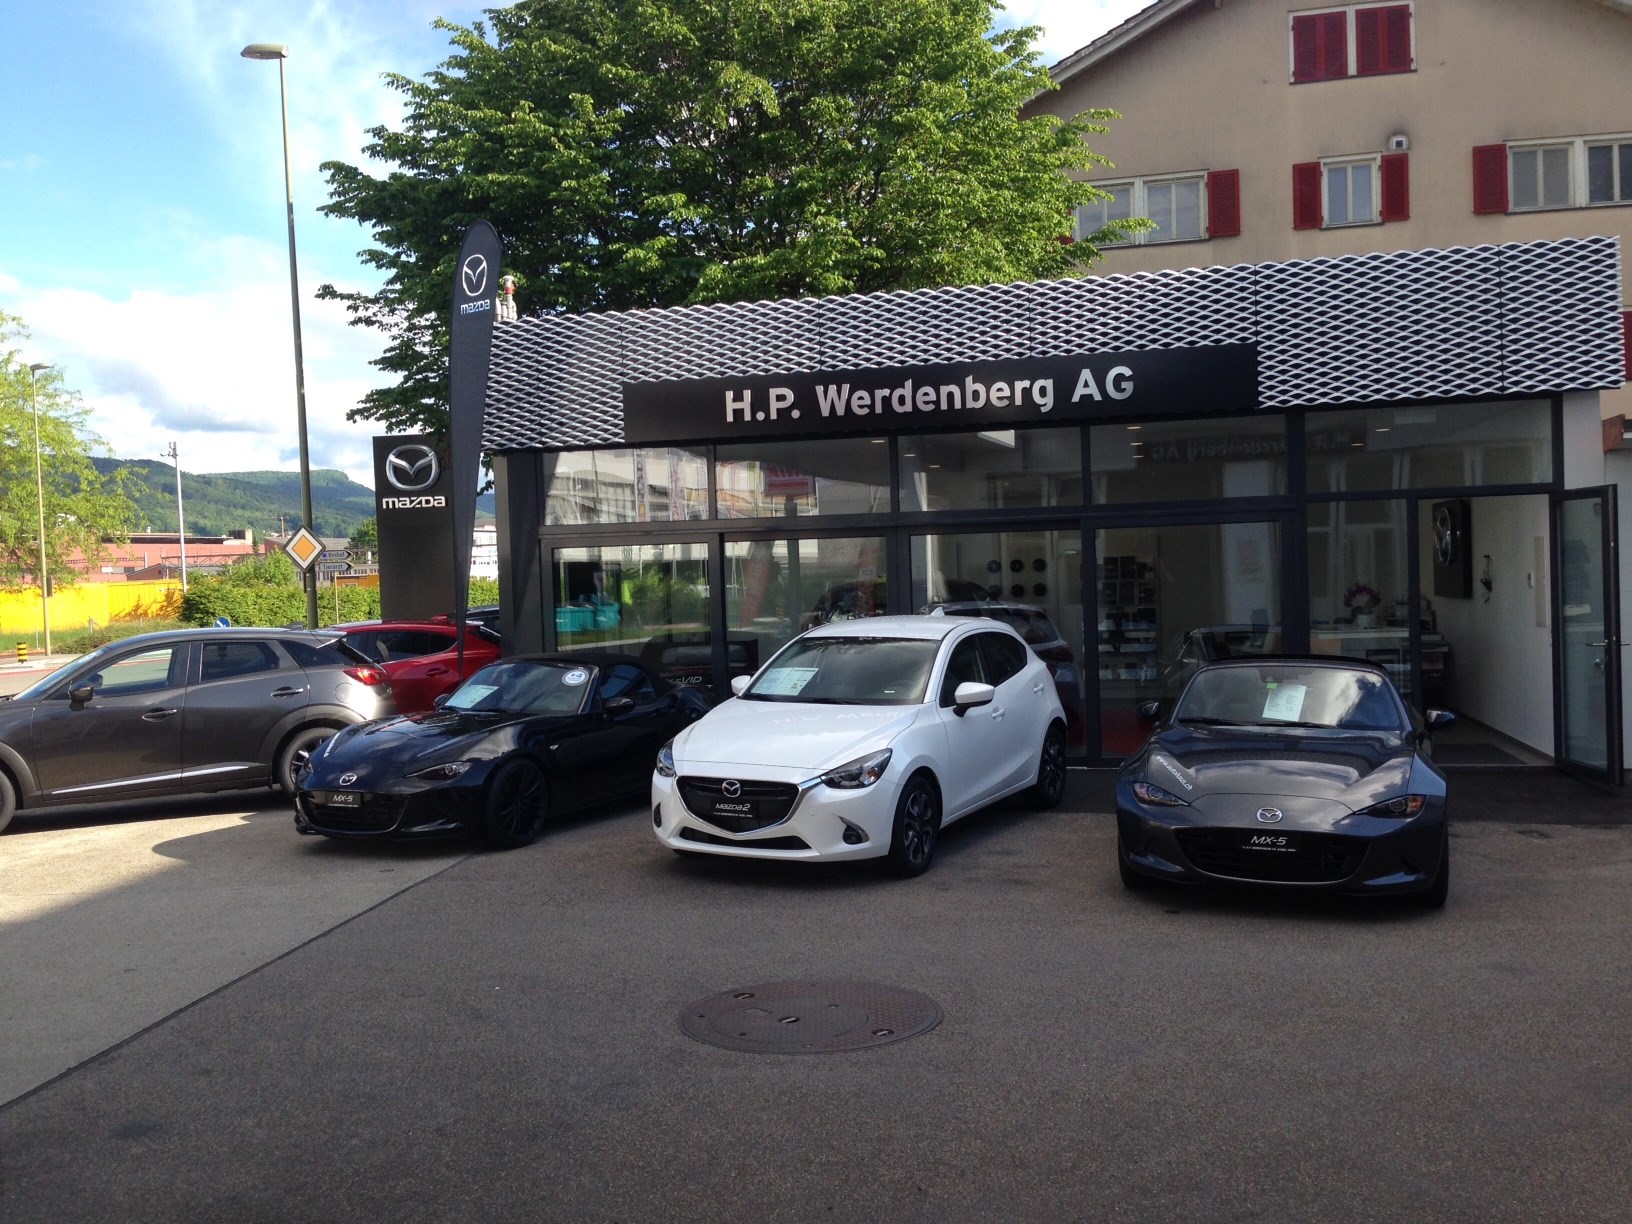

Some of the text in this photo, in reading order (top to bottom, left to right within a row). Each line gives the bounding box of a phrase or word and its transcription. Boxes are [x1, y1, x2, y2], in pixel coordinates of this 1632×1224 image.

[725, 365, 1134, 423] H.P. Werdenberg AG
[332, 794, 354, 802] MX-5
[1250, 835, 1289, 846] MX-5
